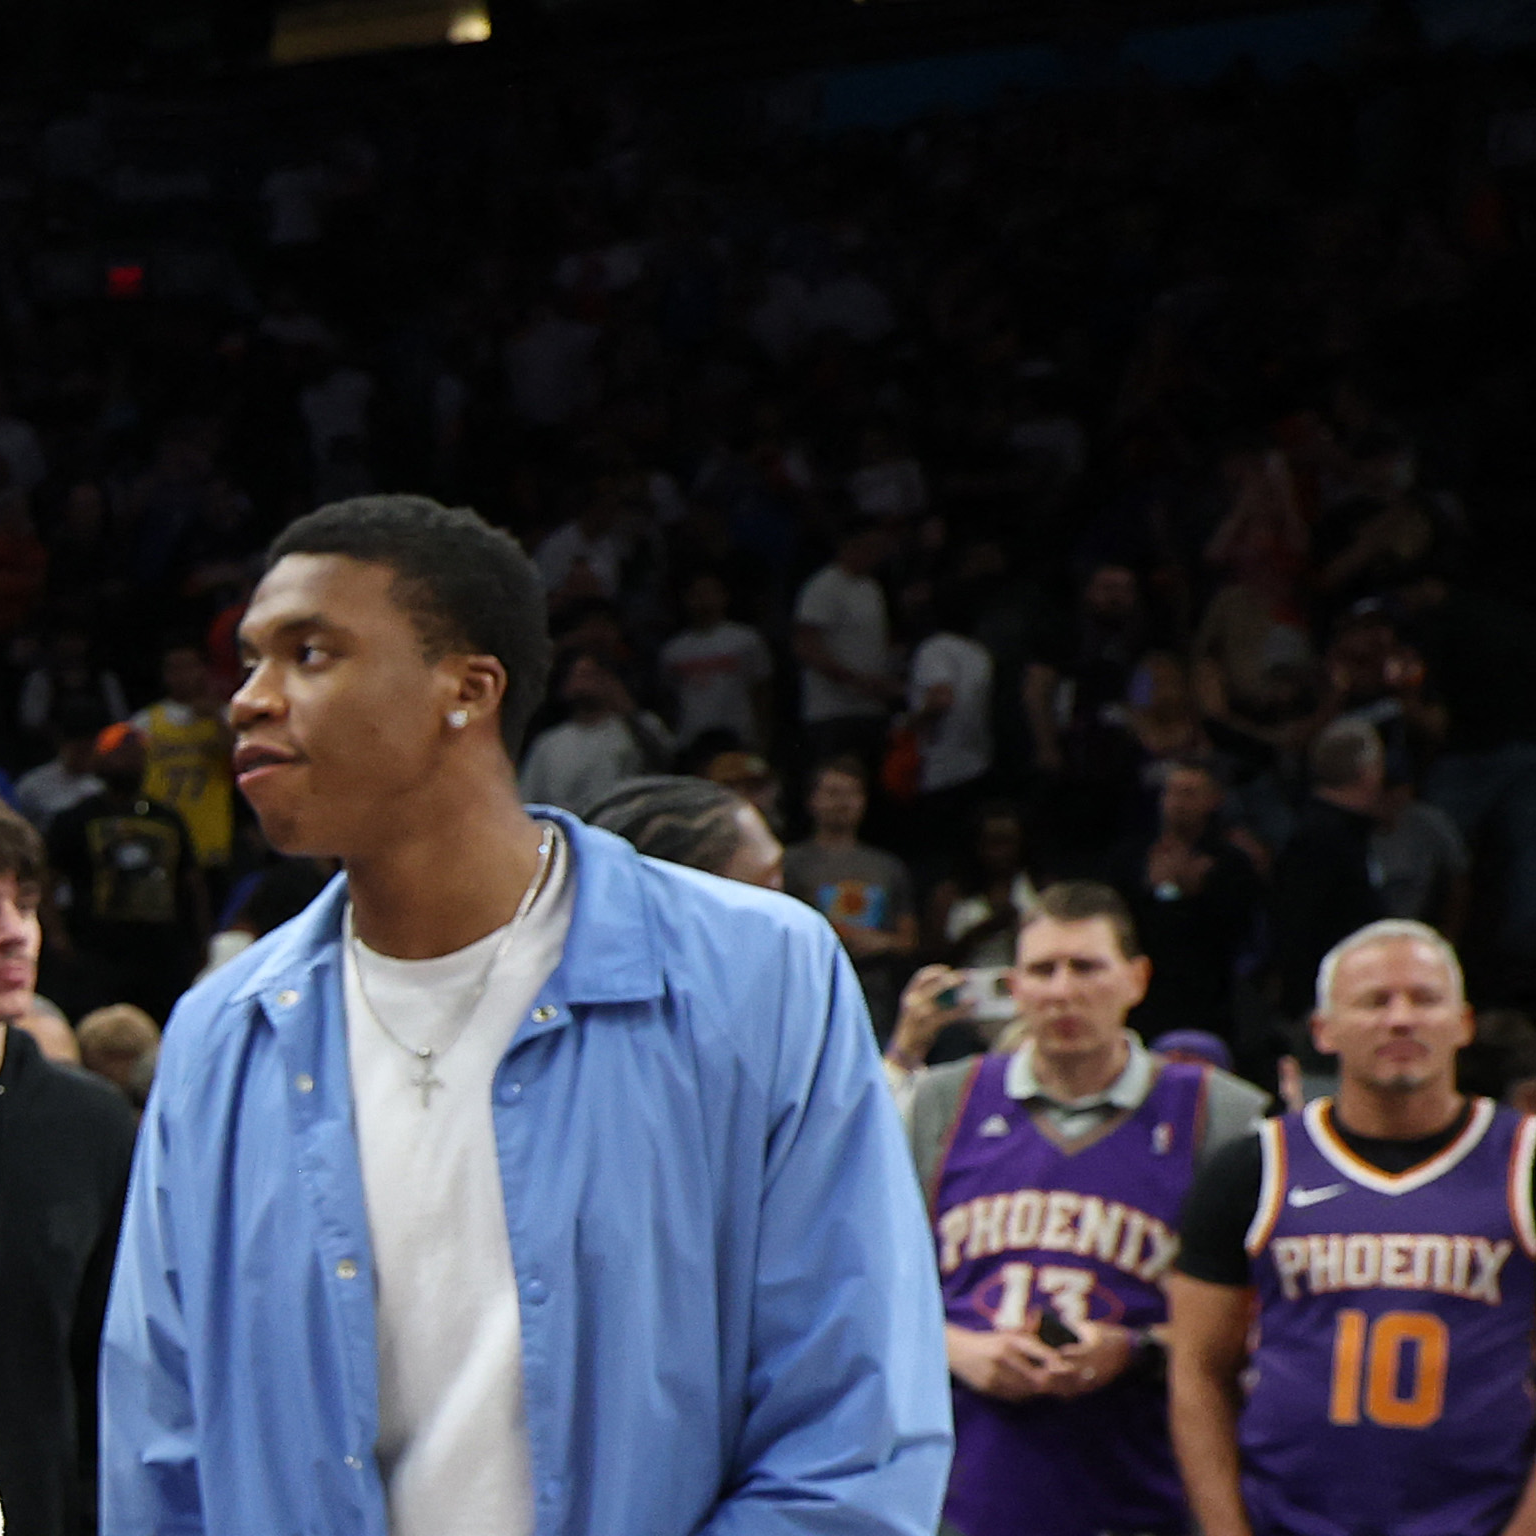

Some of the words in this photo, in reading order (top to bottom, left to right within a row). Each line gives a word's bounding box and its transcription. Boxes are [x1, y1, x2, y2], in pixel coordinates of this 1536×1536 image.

[939, 1188, 1180, 1282] PHOENIX
[1270, 1232, 1514, 1307] PHOENIX
[1329, 1307, 1449, 1429] 10
